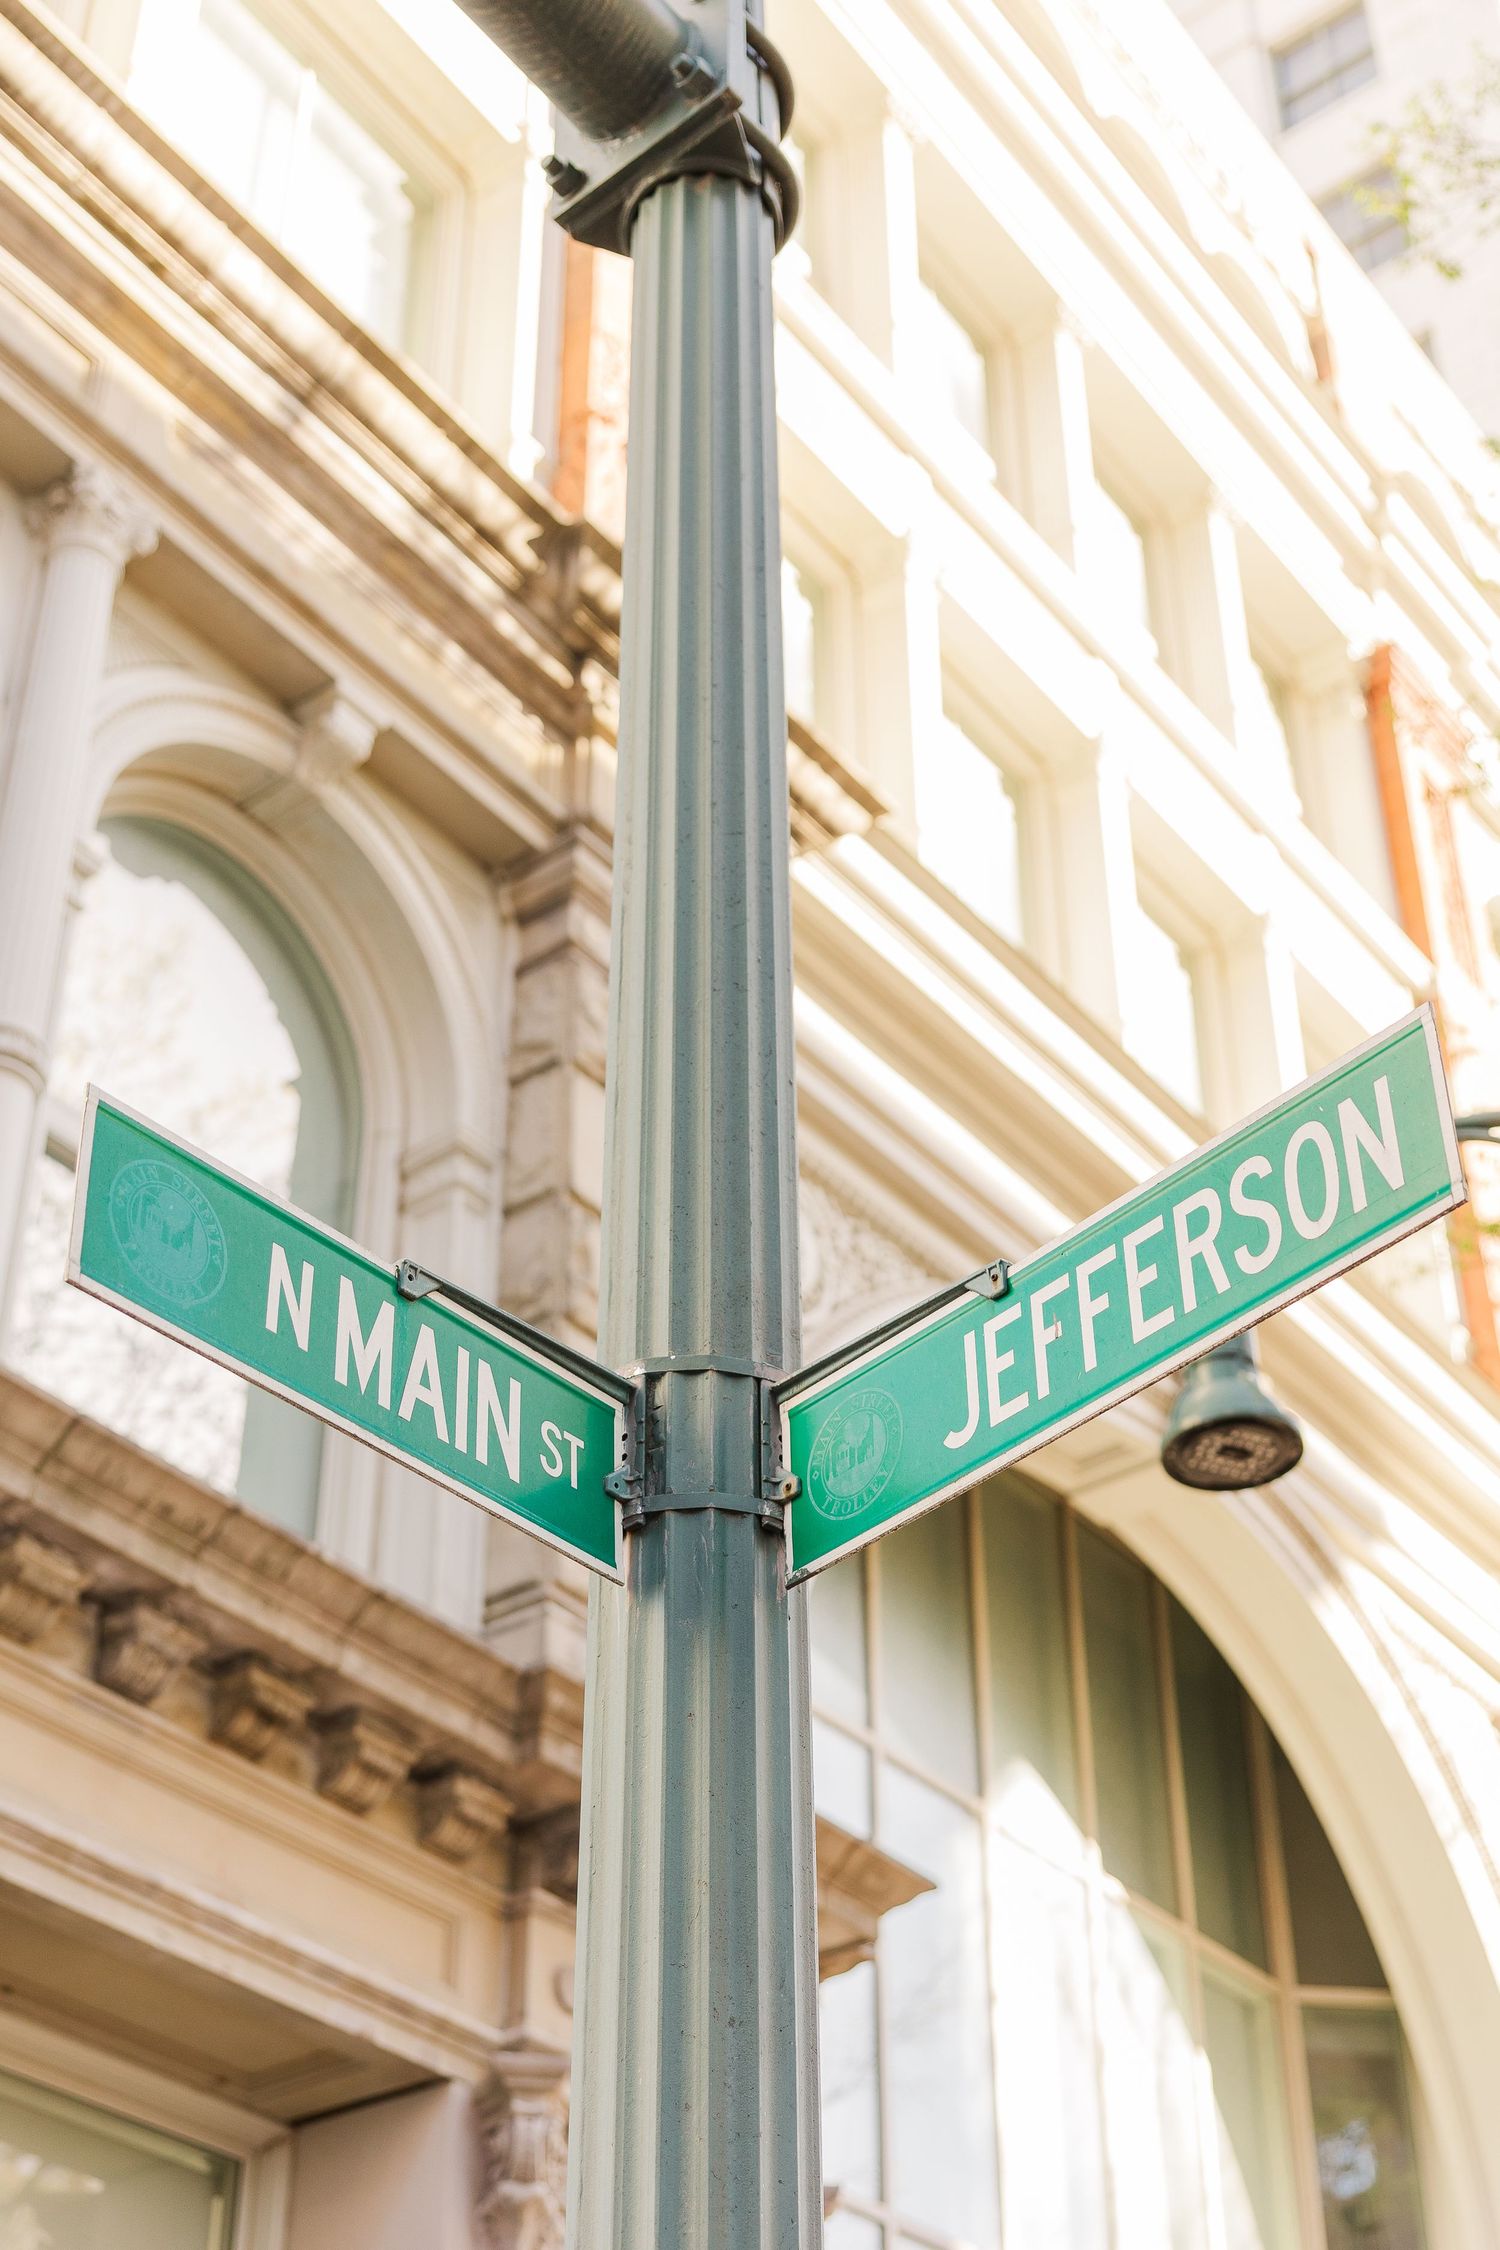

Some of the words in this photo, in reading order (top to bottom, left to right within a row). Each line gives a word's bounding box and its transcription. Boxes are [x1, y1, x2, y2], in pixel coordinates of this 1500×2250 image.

[171, 1171, 222, 1247] STREET
[943, 1076, 1405, 1449] JEFFERSON
[264, 1242, 315, 1352] N
[334, 1275, 522, 1484] MAIN
[538, 1420, 585, 1490] ST
[812, 1409, 841, 1465] MAIN
[849, 1392, 898, 1422] STREET
[821, 1465, 889, 1515] TROLLEY
